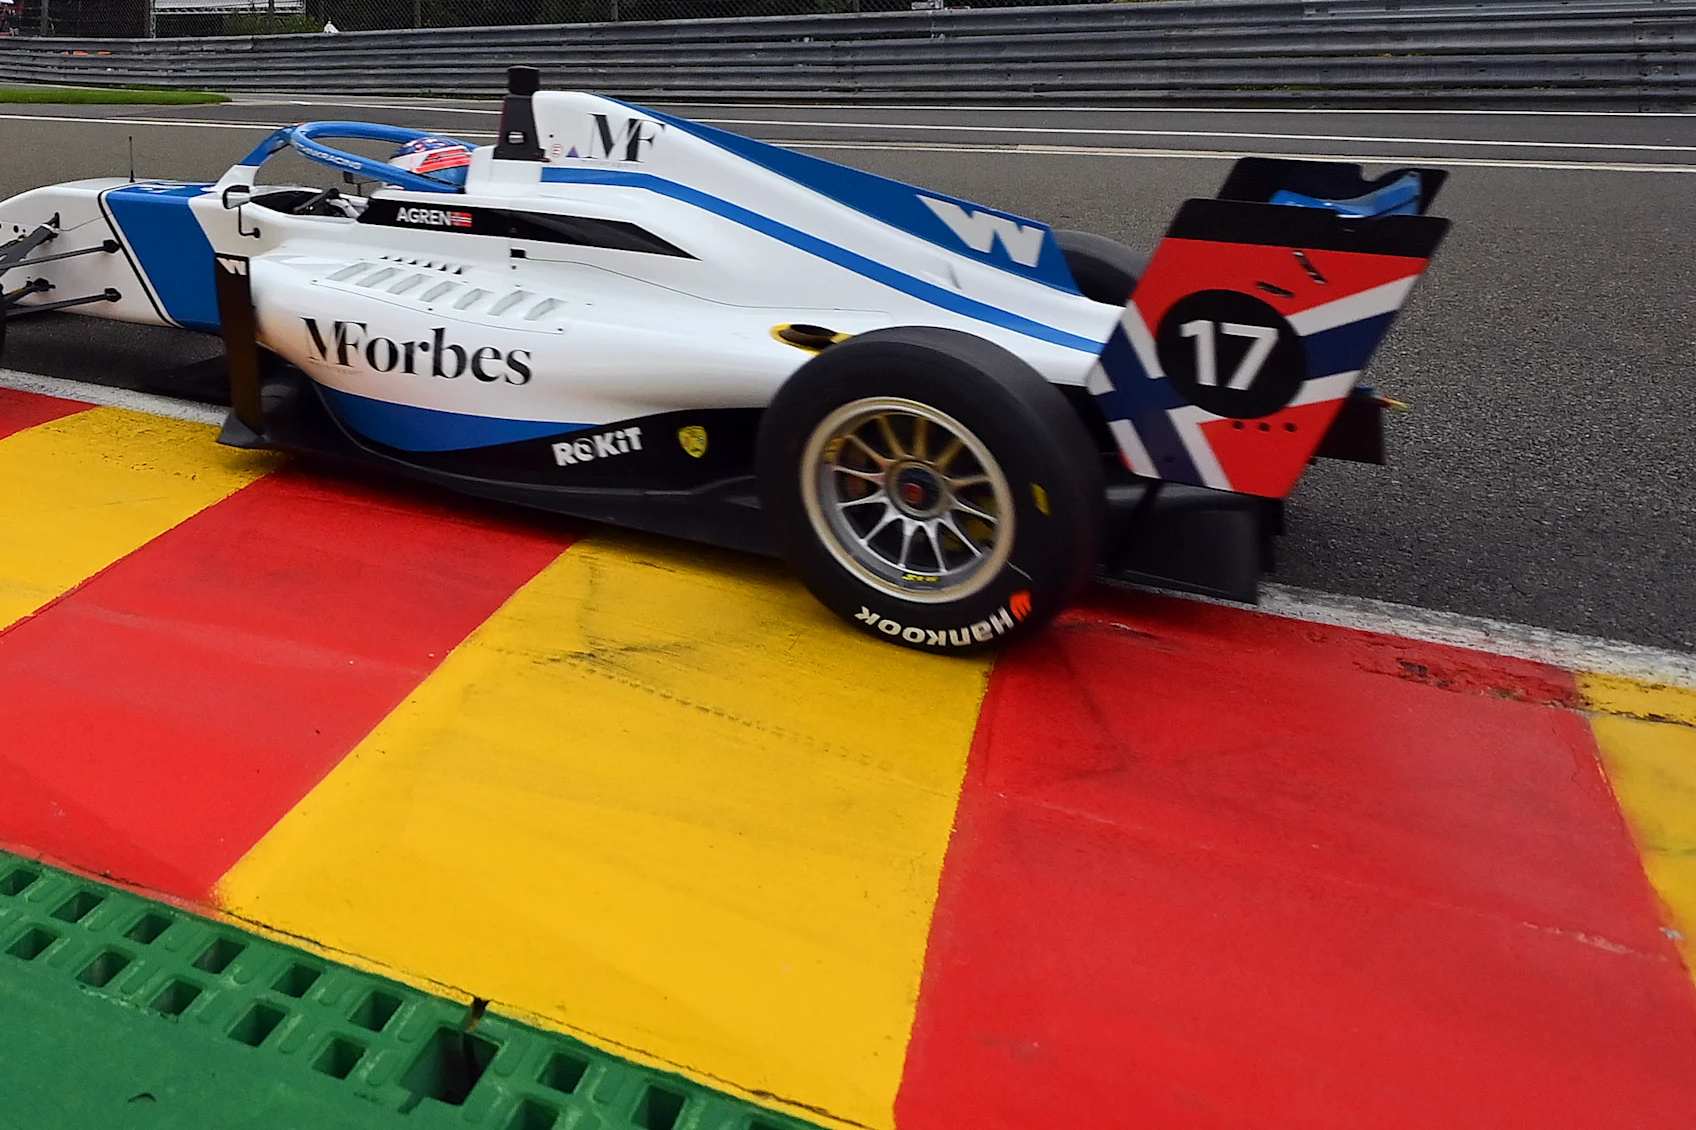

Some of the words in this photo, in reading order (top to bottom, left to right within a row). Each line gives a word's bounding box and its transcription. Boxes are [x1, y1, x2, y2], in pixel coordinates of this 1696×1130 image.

[396, 207, 451, 226] AGREN
[916, 194, 1045, 268] W
[1180, 320, 1280, 391] 17
